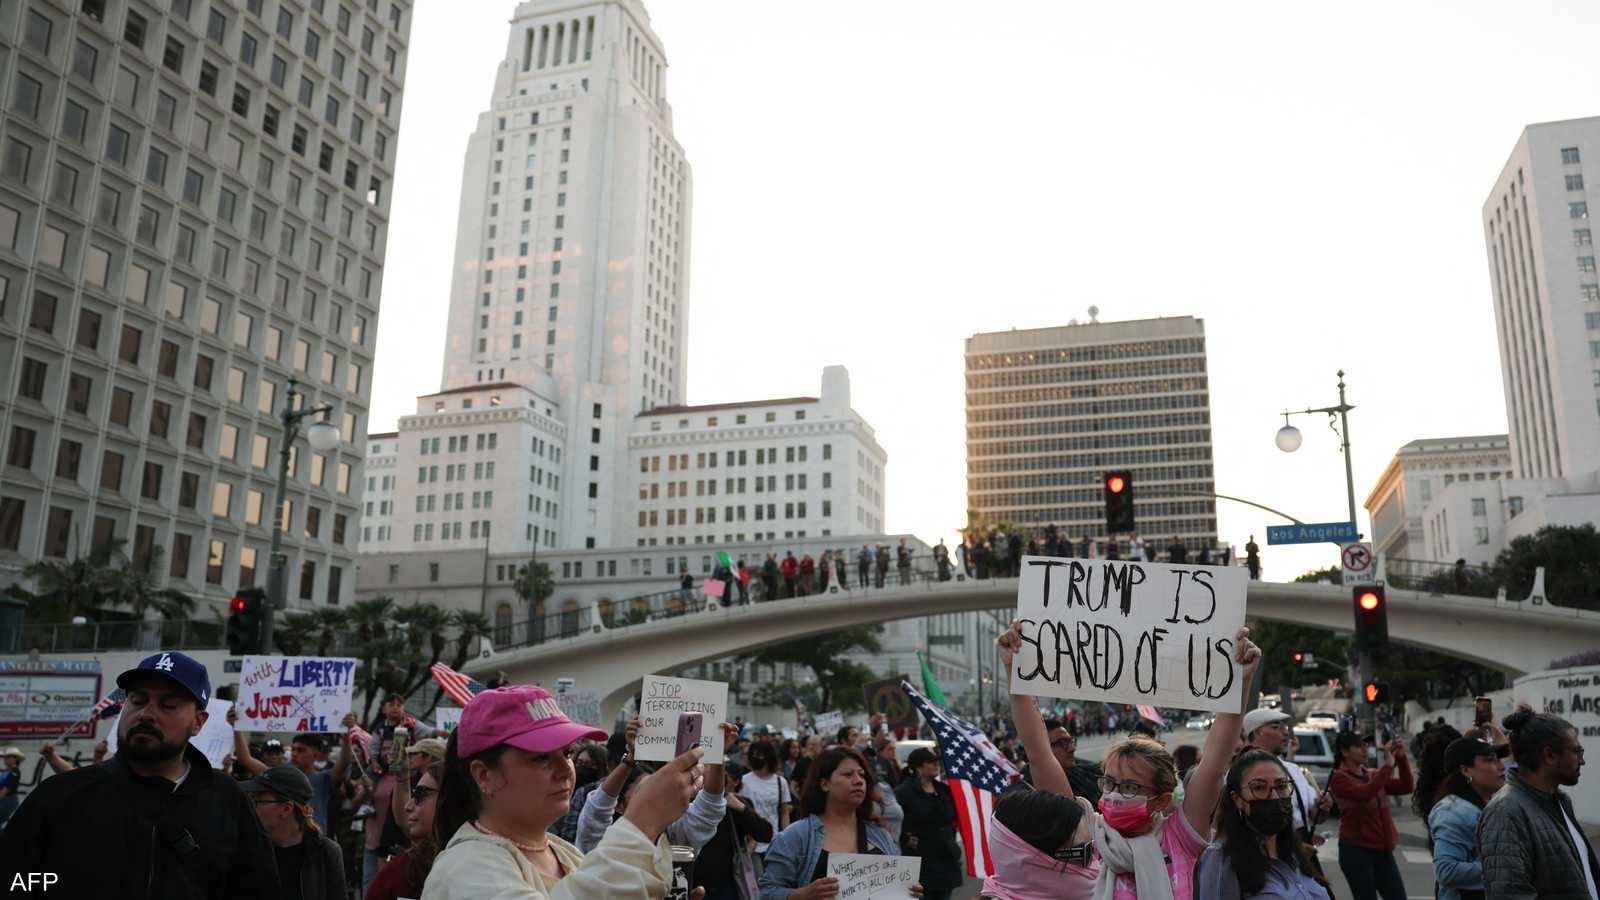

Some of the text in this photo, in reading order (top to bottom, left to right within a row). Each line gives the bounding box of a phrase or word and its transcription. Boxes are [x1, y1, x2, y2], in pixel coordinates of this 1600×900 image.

[1271, 526, 1353, 541] Los Angeles
[1028, 560, 1216, 624] TRUMP IS
[156, 653, 175, 672] LA
[1018, 619, 1234, 699] SCARED OF US
[244, 662, 281, 687] with
[278, 659, 354, 687] LIBERTY
[320, 688, 339, 697] and
[648, 682, 681, 697] STOP
[645, 700, 716, 714] TERRORIZING
[296, 716, 328, 731] ALL
[645, 717, 664, 728] OUR
[832, 860, 856, 874] WHAT
[870, 875, 883, 888] ALL
[885, 873, 896, 884] OF
[899, 869, 911, 882] US
